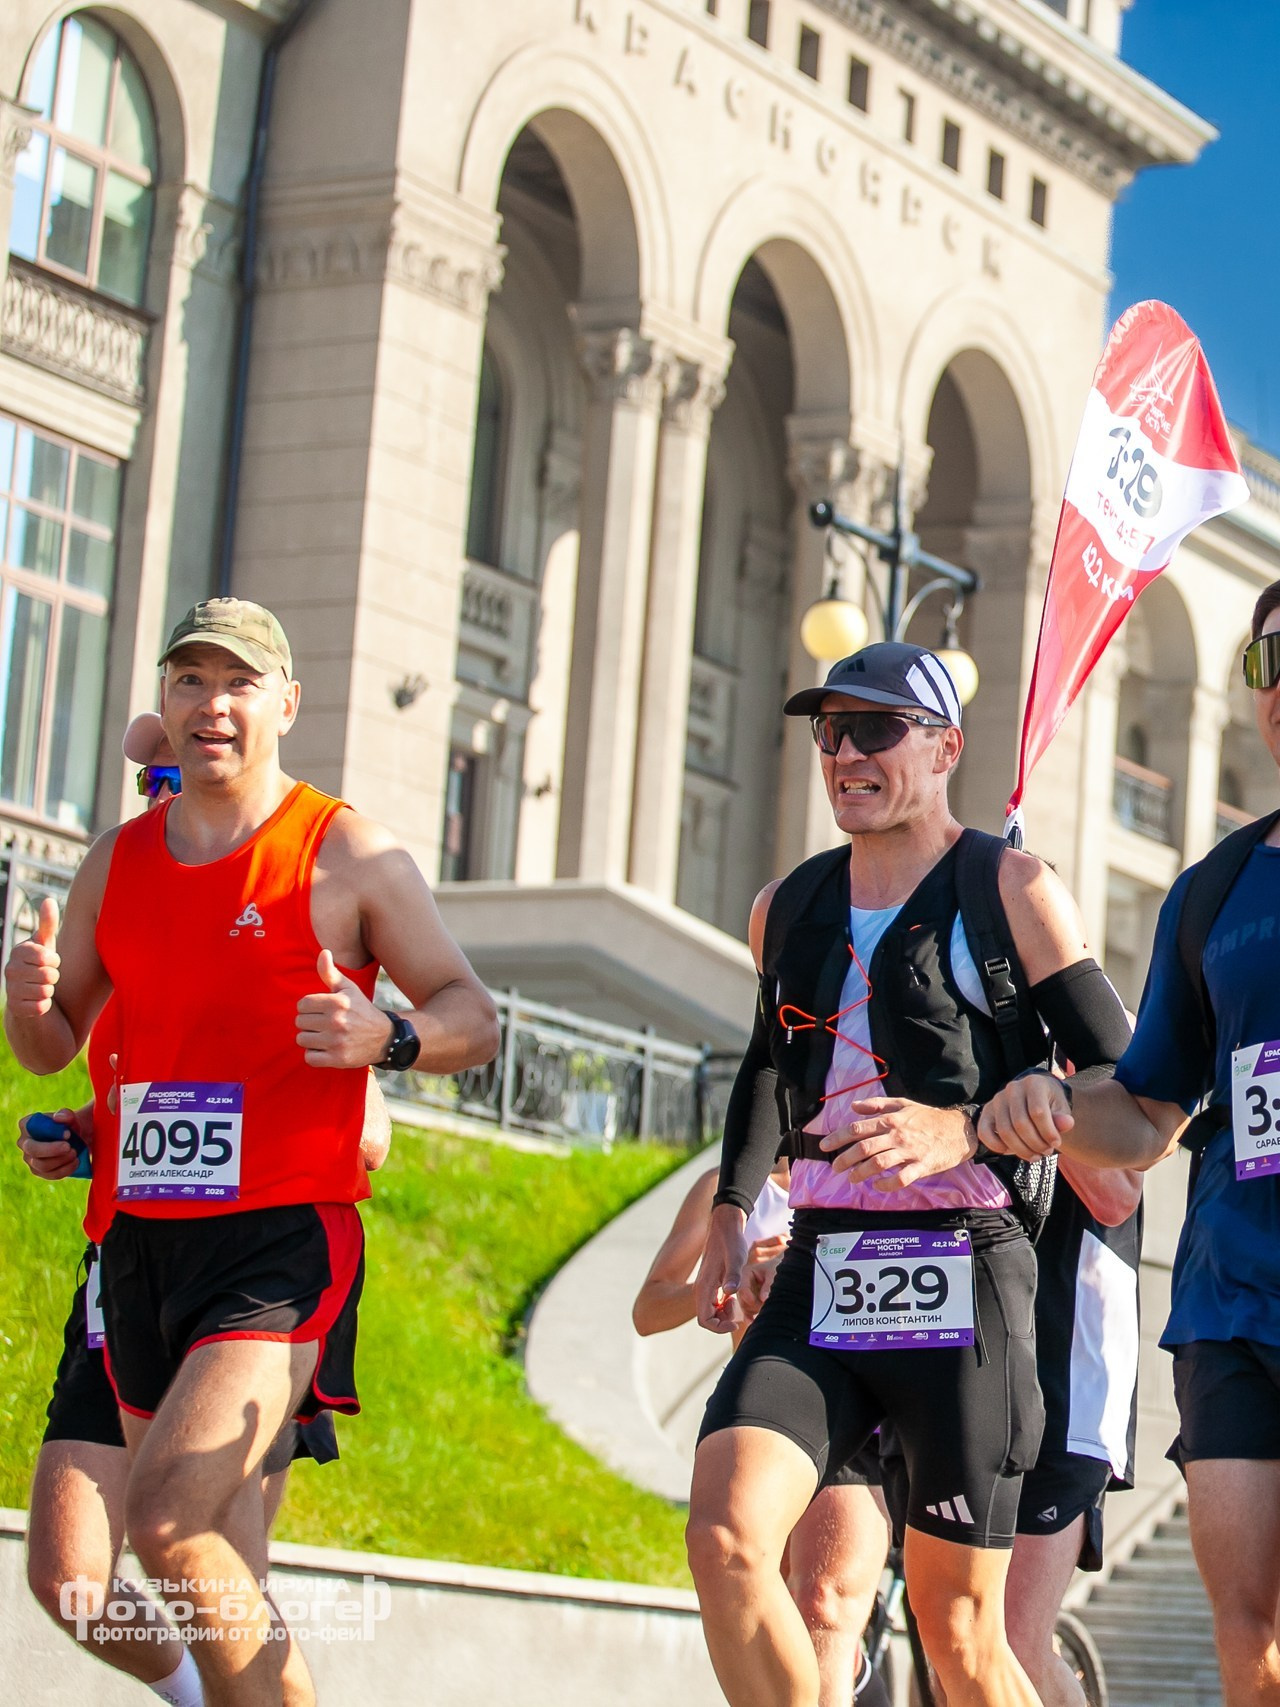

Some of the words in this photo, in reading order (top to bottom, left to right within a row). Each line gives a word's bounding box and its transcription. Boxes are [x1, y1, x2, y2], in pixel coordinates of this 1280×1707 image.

[158, 1097, 180, 1105] МОСТЫ
[122, 1120, 233, 1166] 4095
[159, 1170, 214, 1178] АЛЕКСАНДР
[862, 1236, 920, 1246] КРАСНОЯРСКИЕ
[829, 1247, 847, 1255] СБЕР
[834, 1265, 949, 1315] 3:29
[842, 1318, 874, 1326] ЛИПОВ
[876, 1315, 942, 1325] КОНСТАНТИН
[939, 1332, 959, 1340] 2026
